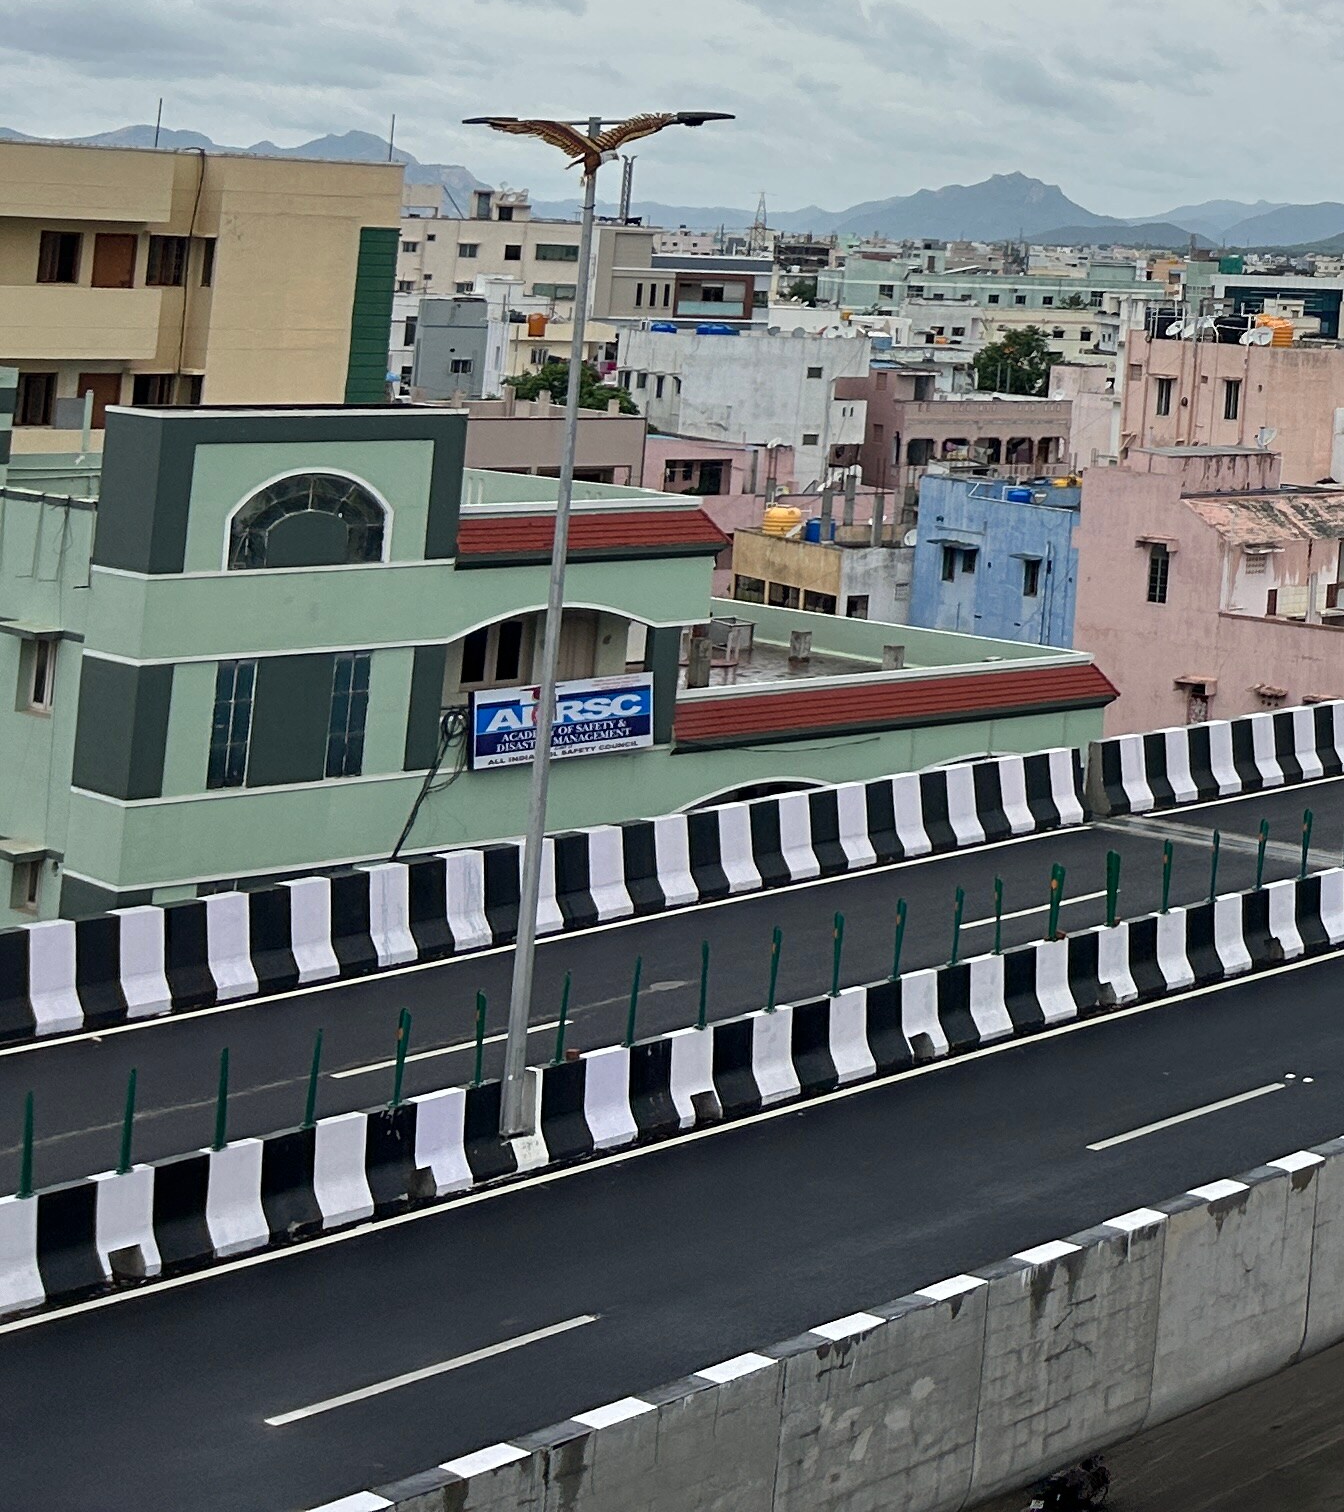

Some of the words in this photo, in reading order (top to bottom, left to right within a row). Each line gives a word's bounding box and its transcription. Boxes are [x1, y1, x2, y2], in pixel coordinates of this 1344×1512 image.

[496, 739, 537, 753] DISAST
[552, 727, 632, 746] MANAGEMENT
[558, 724, 574, 736] OF
[575, 720, 616, 734] SAFETY
[617, 718, 627, 728] &
[488, 757, 506, 766] ALL
[508, 754, 535, 763] INDIA
[561, 745, 597, 756] SAFETY
[598, 740, 639, 751] COUNCIL
